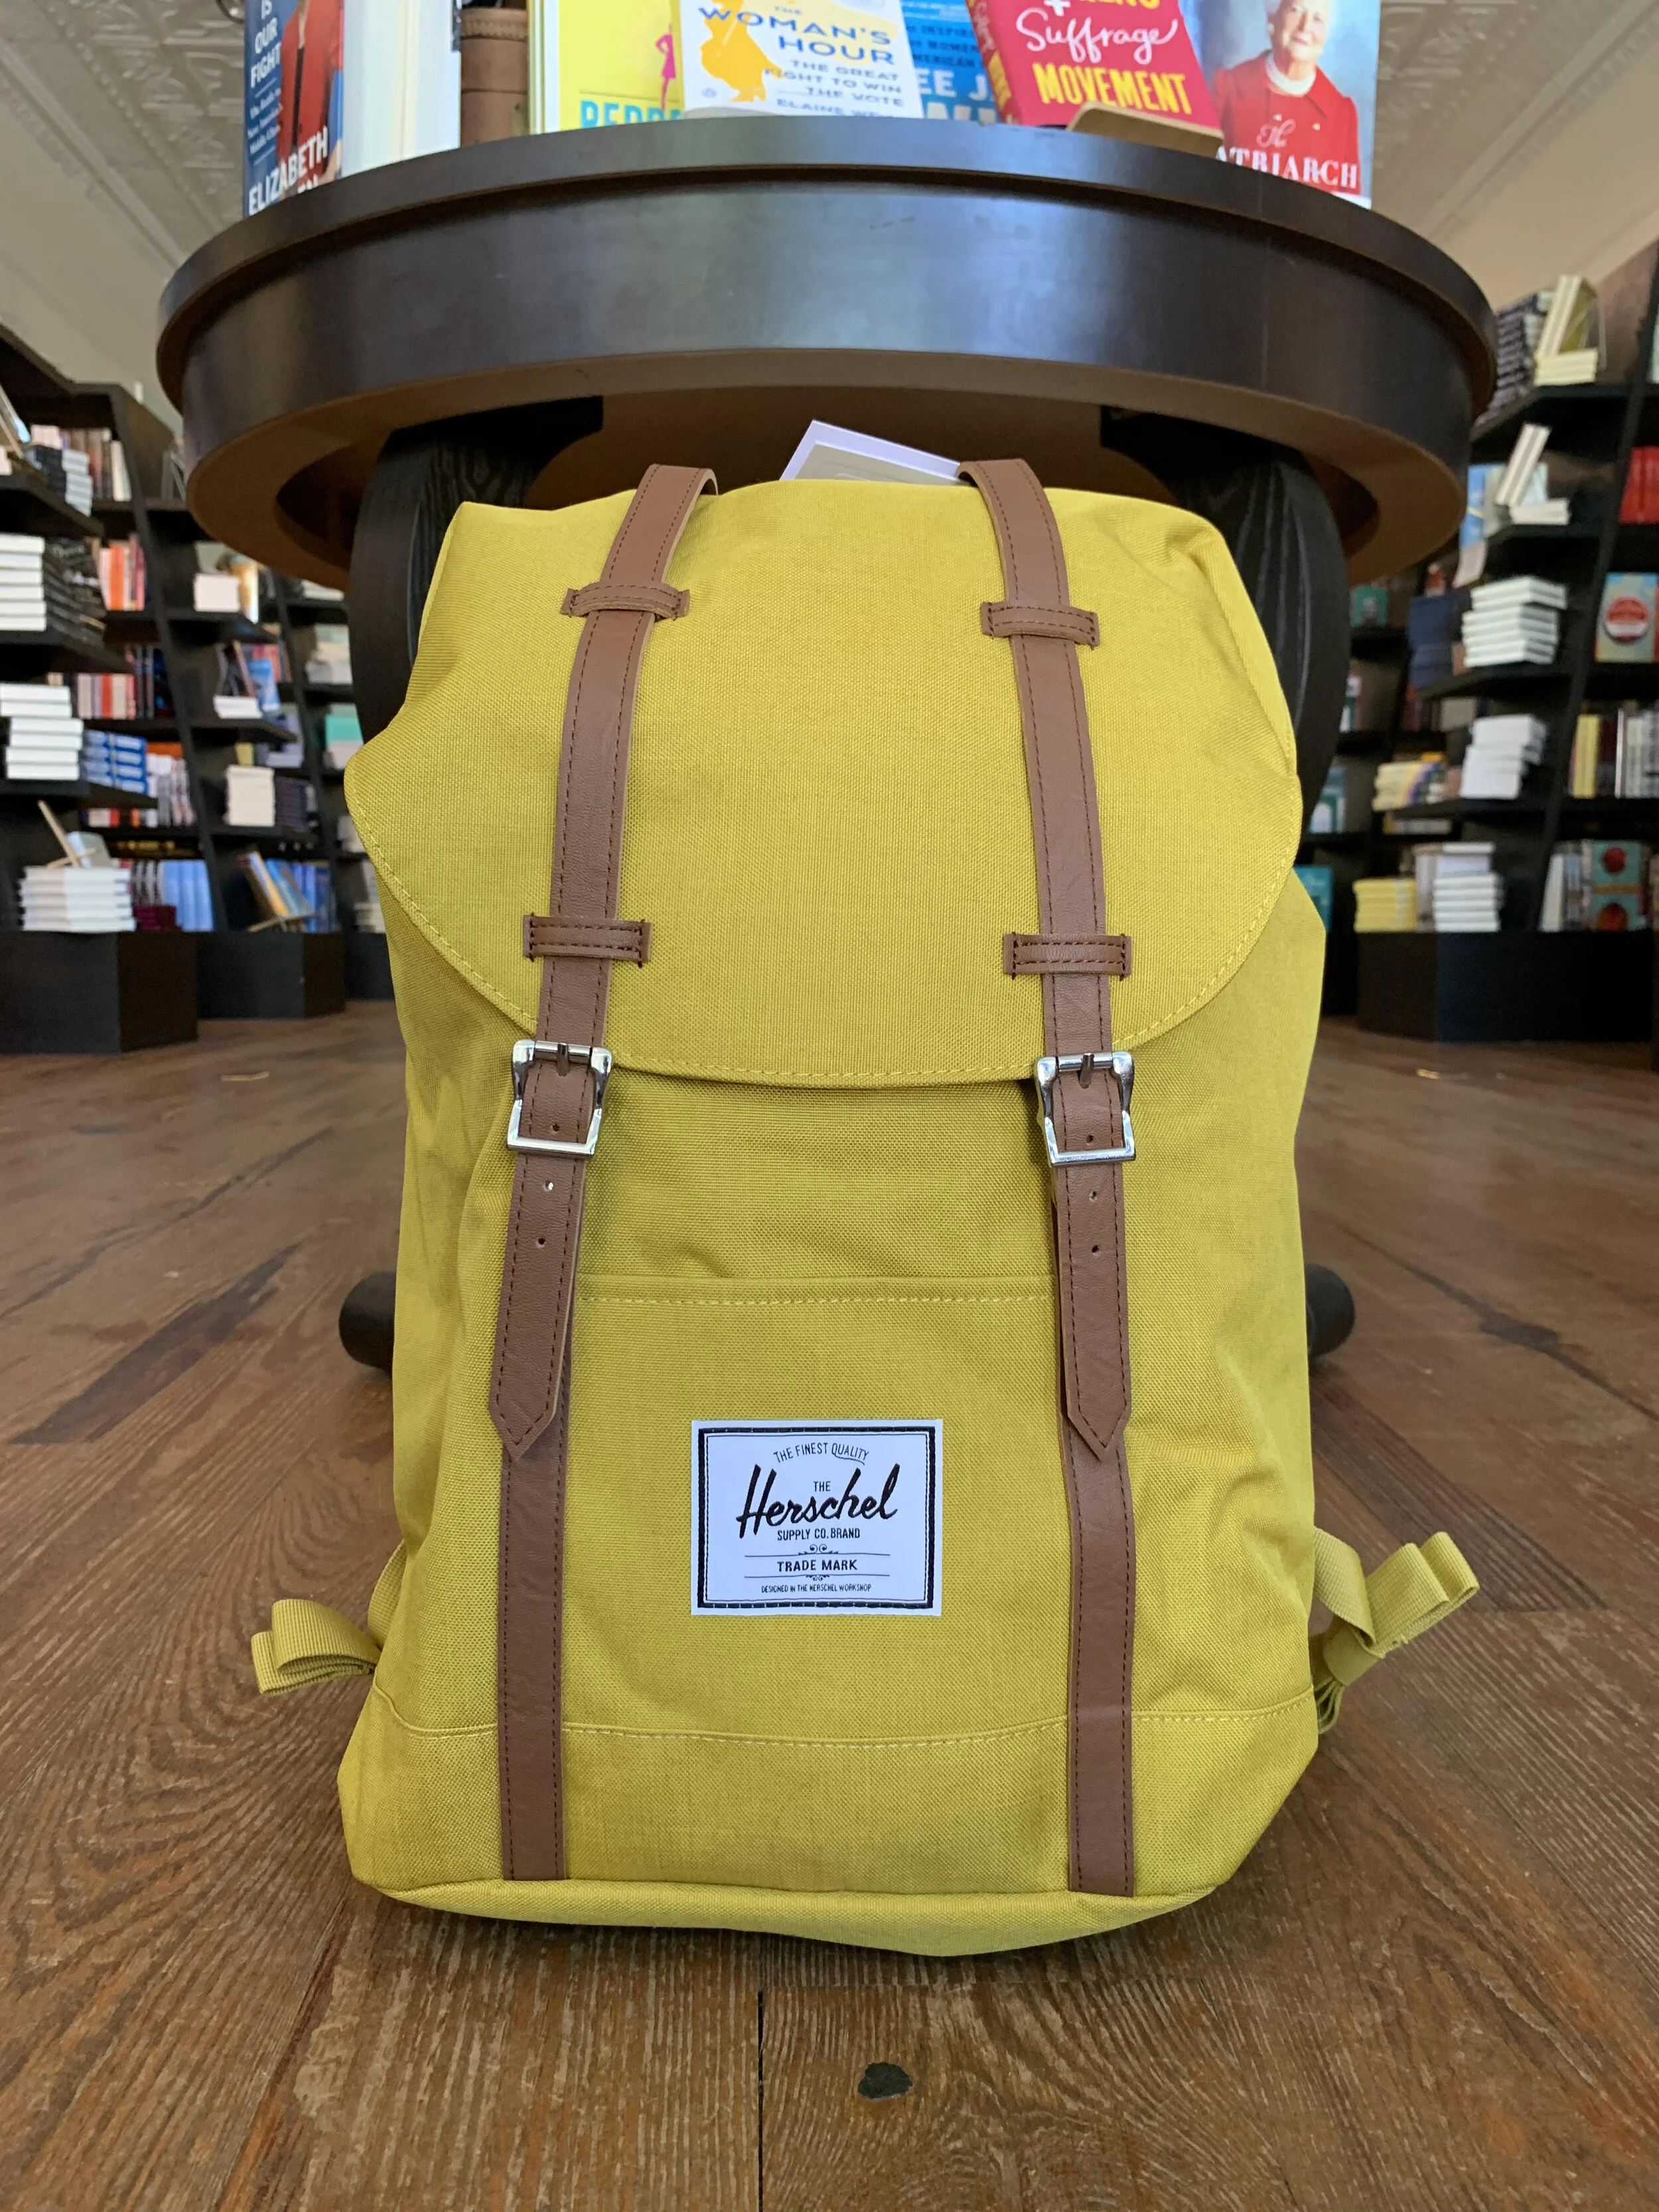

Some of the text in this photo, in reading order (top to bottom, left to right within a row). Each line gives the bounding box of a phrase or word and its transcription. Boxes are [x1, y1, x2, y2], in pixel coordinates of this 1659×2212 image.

[255, 17, 277, 54] OUR
[698, 7, 891, 45] WOMAN'S
[1016, 7, 1179, 65] Suffrage
[250, 41, 281, 88] FIGHT
[779, 35, 895, 66] HOUR
[790, 59, 898, 81] THE GREAT
[806, 87, 903, 108] THE VOTE
[831, 78, 857, 88] TO
[863, 82, 902, 94] WIN
[1031, 62, 1192, 115] MOVEMENT
[249, 125, 328, 216] ELIZABETH
[1215, 145, 1358, 189] ATRIARCH
[773, 1442, 870, 1465] THE FINEST QUALITY
[735, 1463, 901, 1539] Herschel
[813, 1481, 831, 1493] THE
[777, 1528, 861, 1541] SUPPLY CO. BRAND
[777, 1559, 858, 1572] TRADE MARK
[809, 1584, 837, 1592] HERSCHEL
[839, 1583, 872, 1592] WORKSHOP
